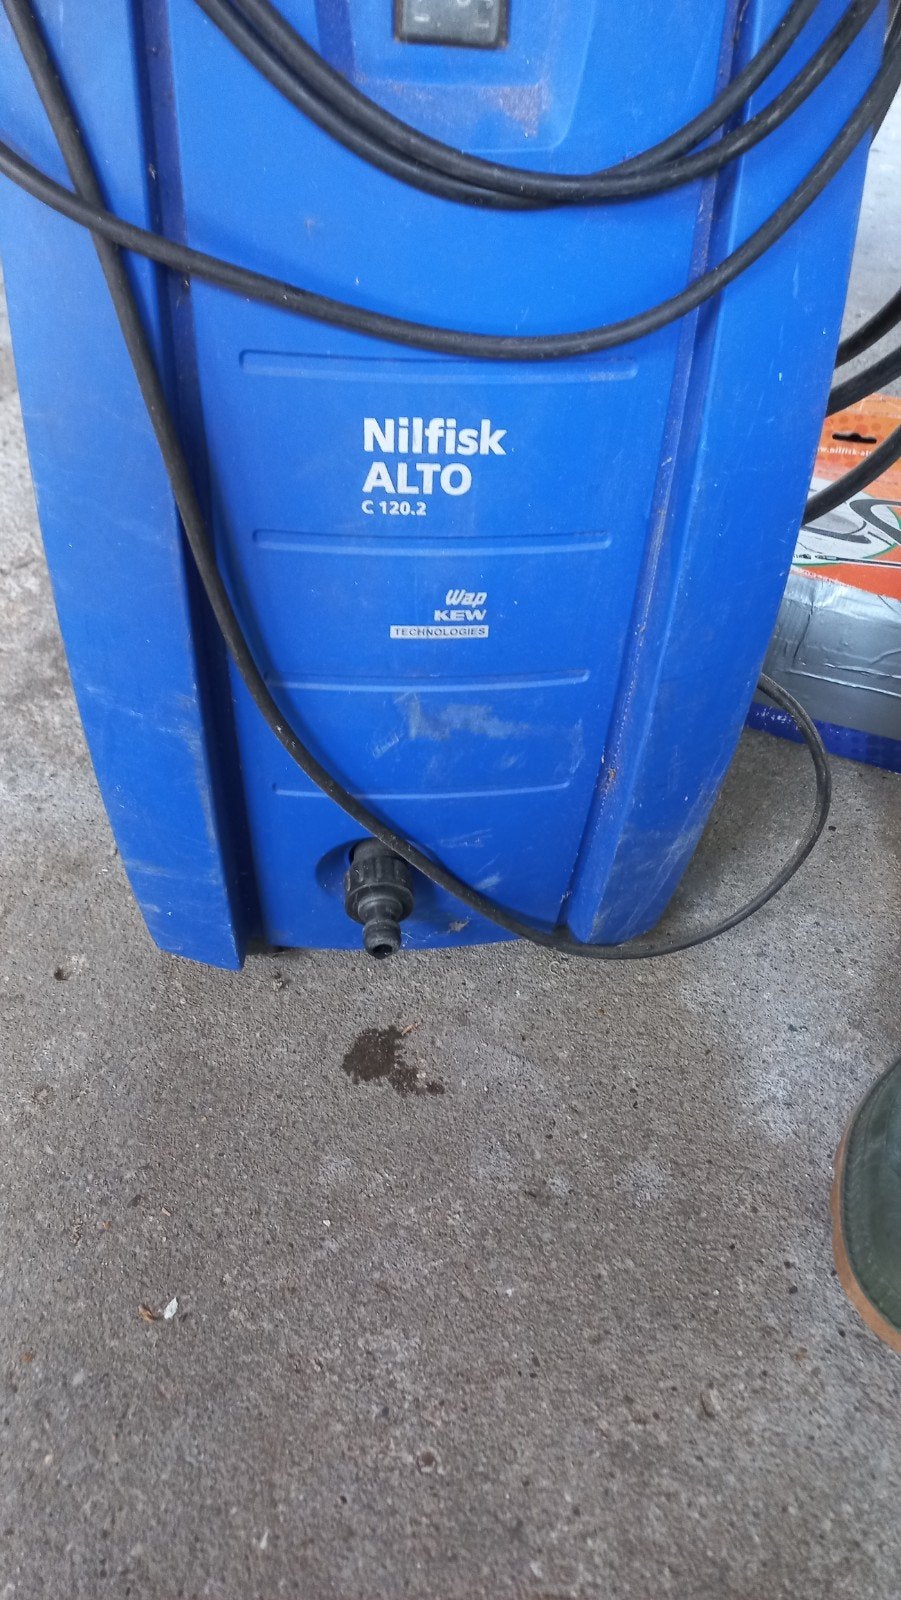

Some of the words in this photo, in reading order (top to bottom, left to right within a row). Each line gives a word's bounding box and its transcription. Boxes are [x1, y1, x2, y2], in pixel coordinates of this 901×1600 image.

[363, 417, 507, 456] Nilfisk
[362, 461, 473, 496] ALTO
[361, 499, 374, 515] C
[379, 500, 427, 516] 120.2
[445, 589, 488, 608] Wap
[434, 609, 487, 622] KEW
[392, 626, 486, 637] TECHNOLOGIES
